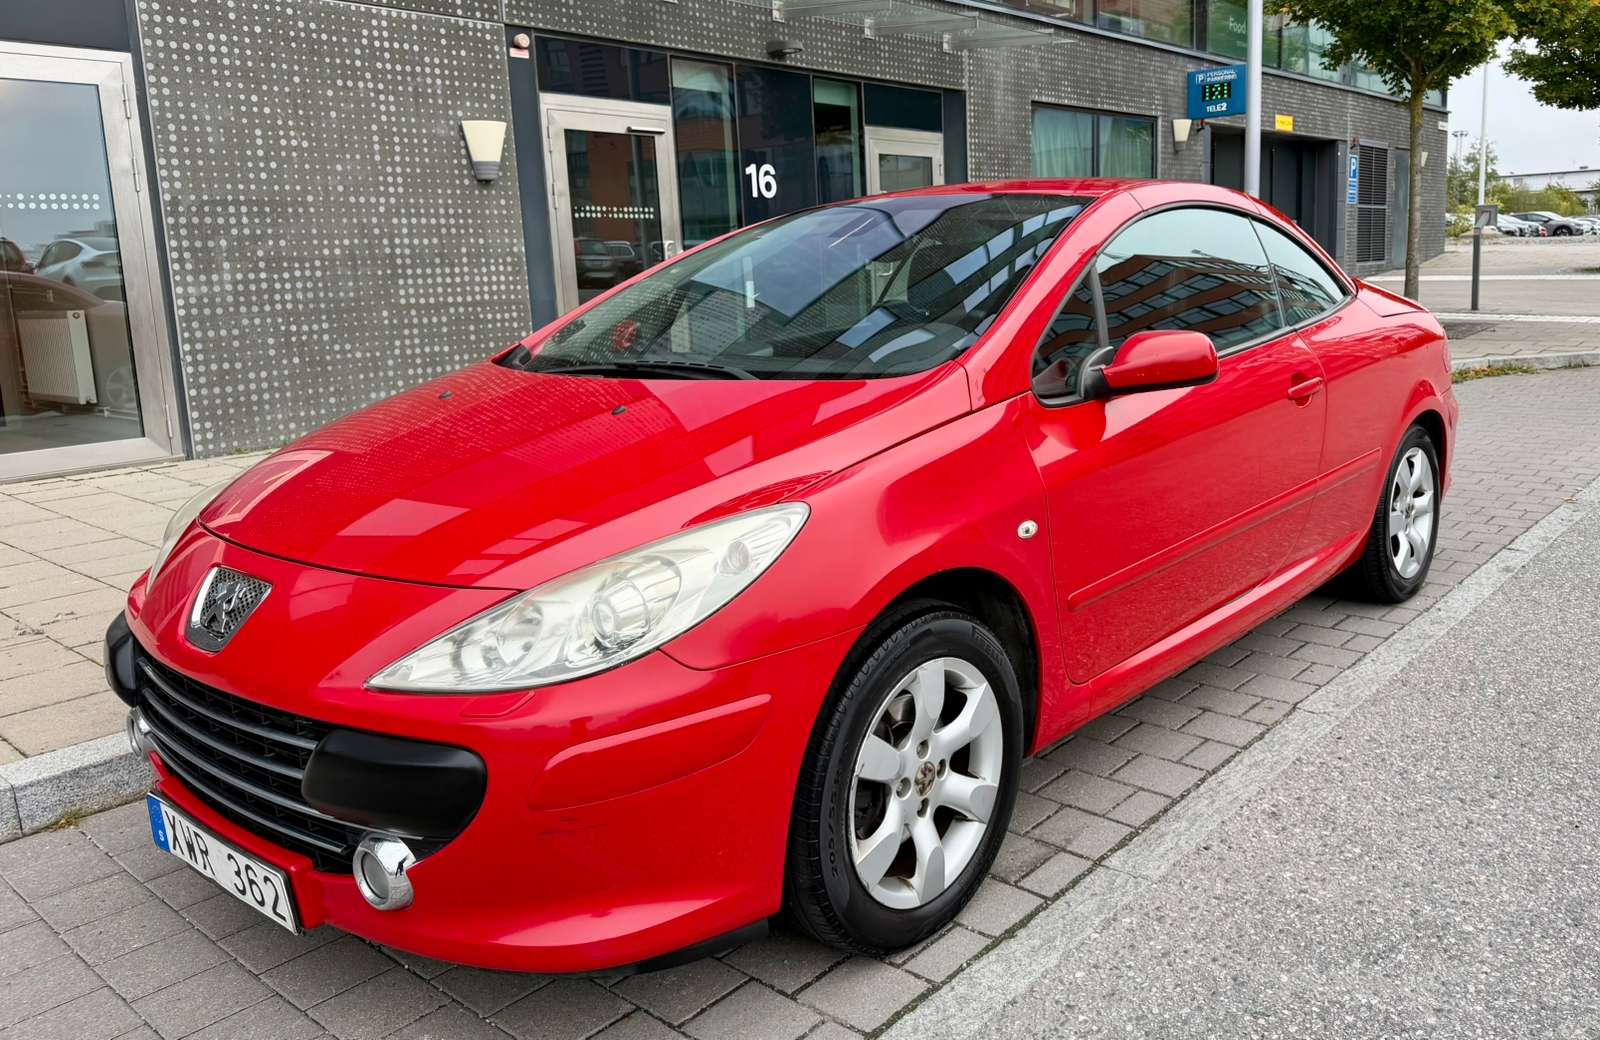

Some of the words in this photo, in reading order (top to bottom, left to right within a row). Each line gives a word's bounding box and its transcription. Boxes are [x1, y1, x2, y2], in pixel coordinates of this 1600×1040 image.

[1229, 17, 1246, 34] Food
[1206, 74, 1238, 82] PARKERING
[1205, 83, 1228, 100] 121
[1206, 102, 1227, 112] TELE2
[1350, 157, 1357, 177] P
[745, 163, 777, 198] 16
[970, 625, 1004, 667] PIRELLI
[158, 830, 165, 841] S
[828, 790, 840, 879] 205/55
[164, 809, 216, 876] XWR
[227, 853, 288, 923] 362
